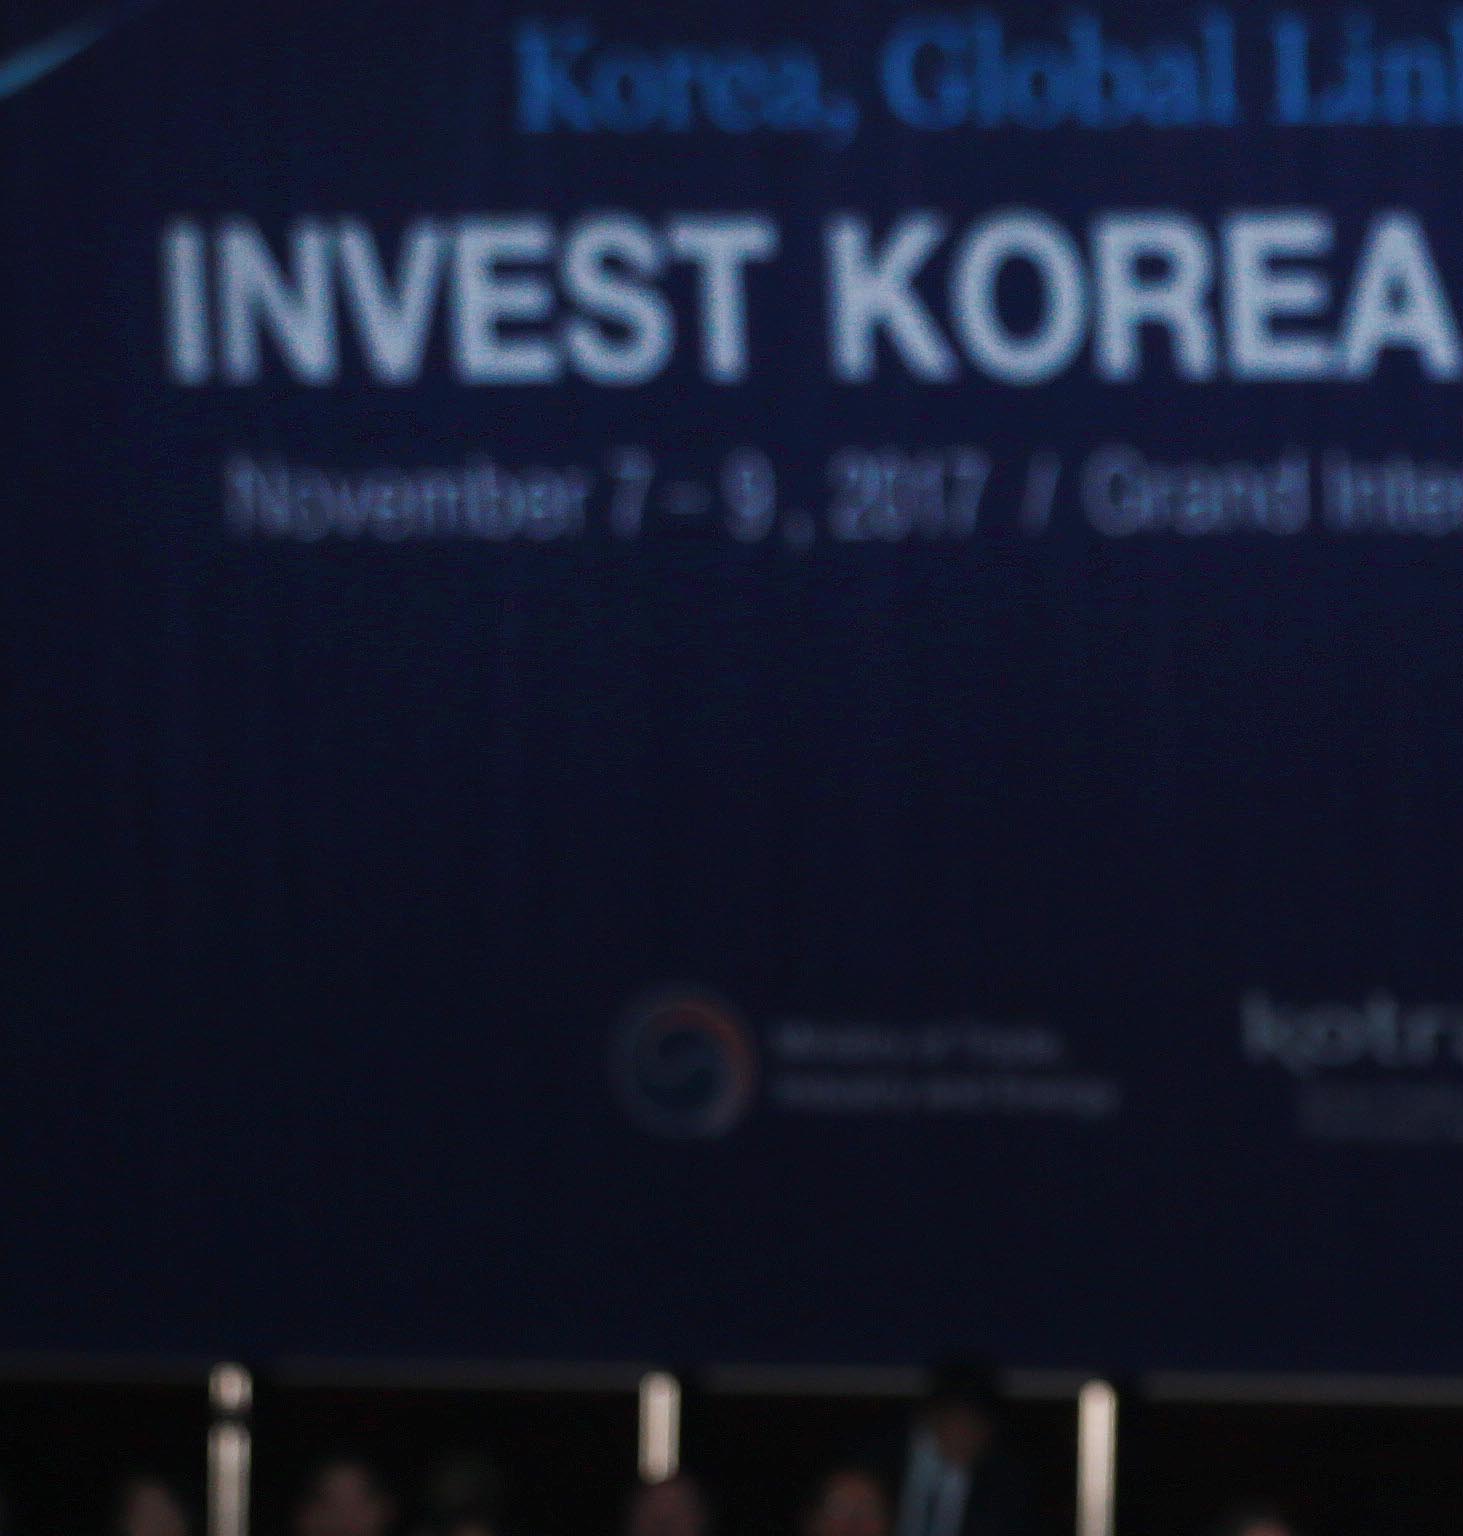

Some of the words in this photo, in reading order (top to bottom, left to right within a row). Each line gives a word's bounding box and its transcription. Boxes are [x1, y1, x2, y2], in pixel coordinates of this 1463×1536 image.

[514, 22, 858, 142] Korea,
[876, 6, 1240, 130] Global
[164, 213, 777, 384] INVEST
[224, 453, 590, 538] November
[610, 447, 654, 532] 7
[828, 447, 991, 539] 2017
[1080, 445, 1311, 536] Grand
